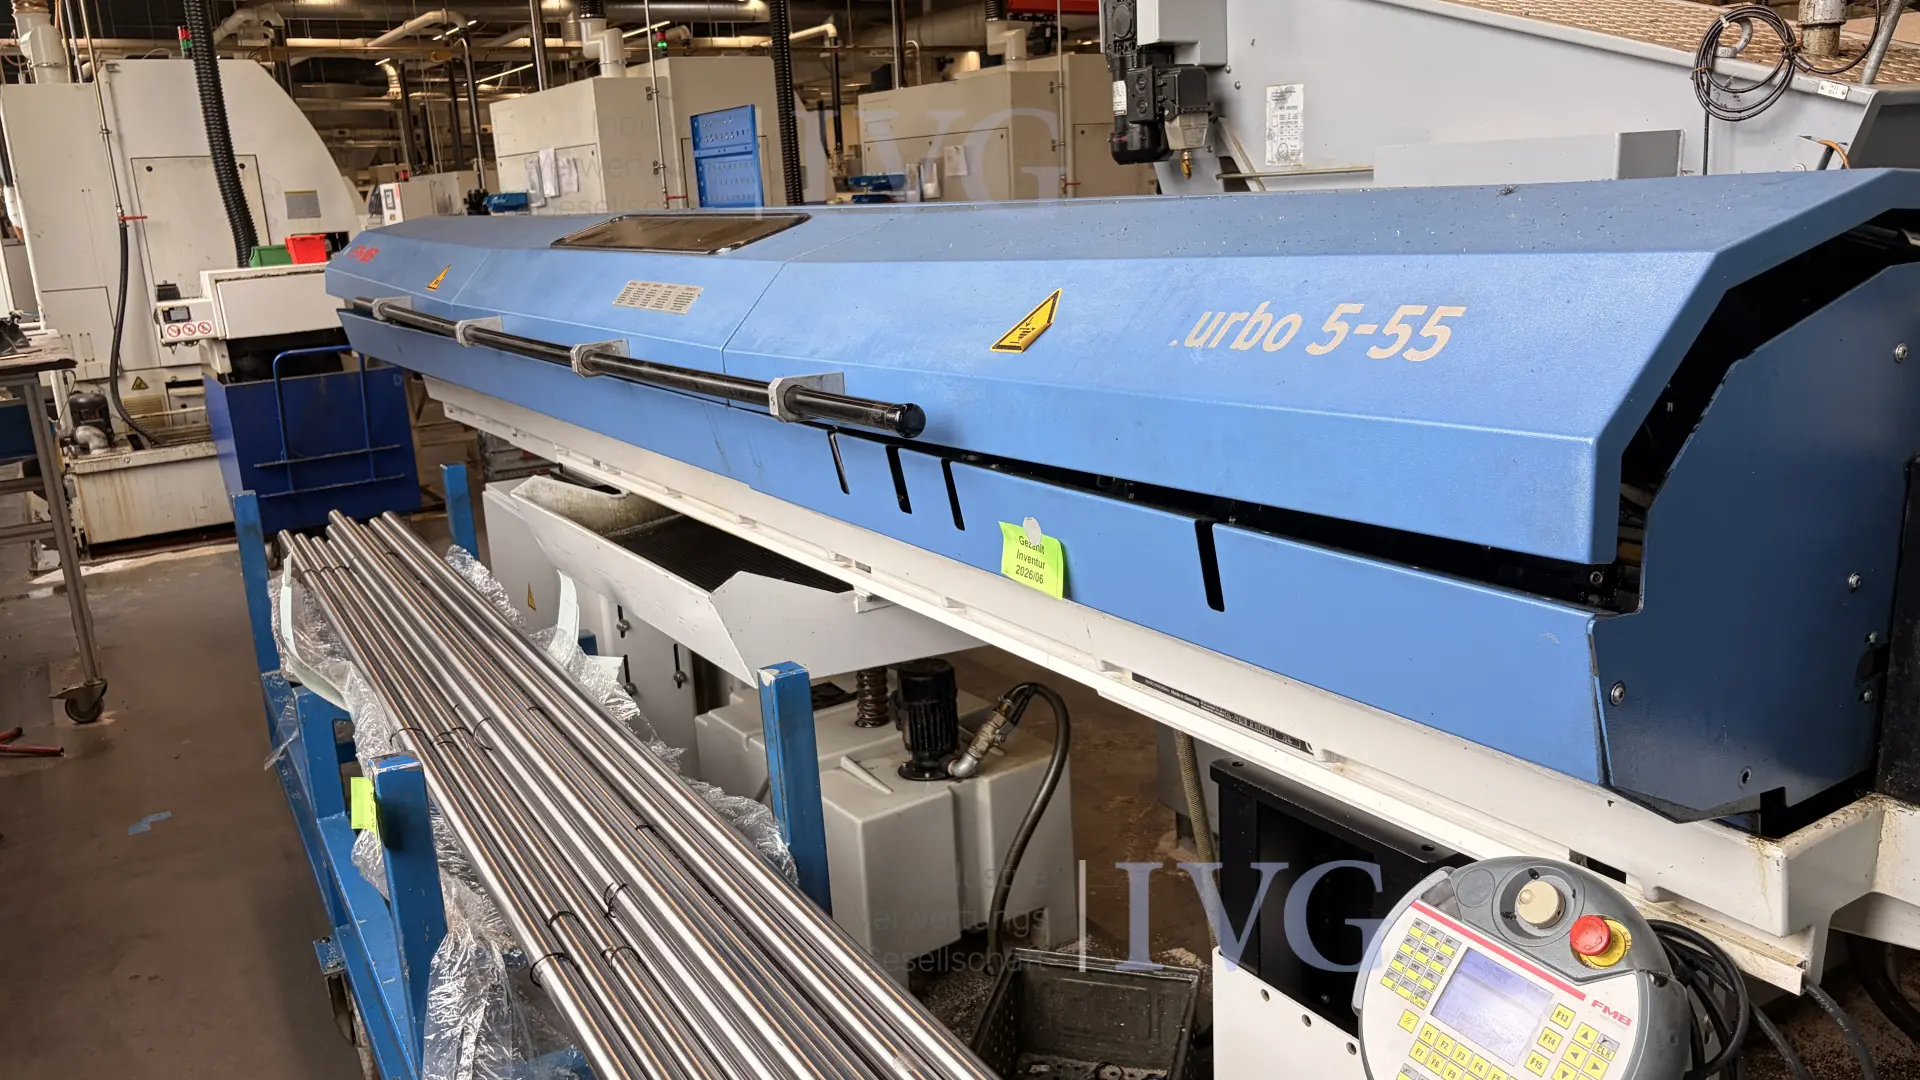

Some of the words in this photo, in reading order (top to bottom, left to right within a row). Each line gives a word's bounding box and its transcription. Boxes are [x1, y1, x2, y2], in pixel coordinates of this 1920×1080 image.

[1167, 300, 1303, 352] urbo
[1305, 303, 1467, 362] 5-55
[1016, 549, 1046, 569] Inventur
[1015, 564, 1044, 584] 2026/06
[1556, 1011, 1569, 1023] F13
[1591, 999, 1632, 1027] FMB
[1424, 1030, 1433, 1039] F1
[1440, 1040, 1449, 1050] F2
[1543, 1035, 1555, 1046] F14
[1415, 1048, 1424, 1057] F7
[1457, 1051, 1466, 1061] F3
[1596, 1043, 1612, 1058] CLR
[1431, 1058, 1440, 1068] F8
[1474, 1062, 1483, 1072] F4
[1530, 1057, 1544, 1069] F15
